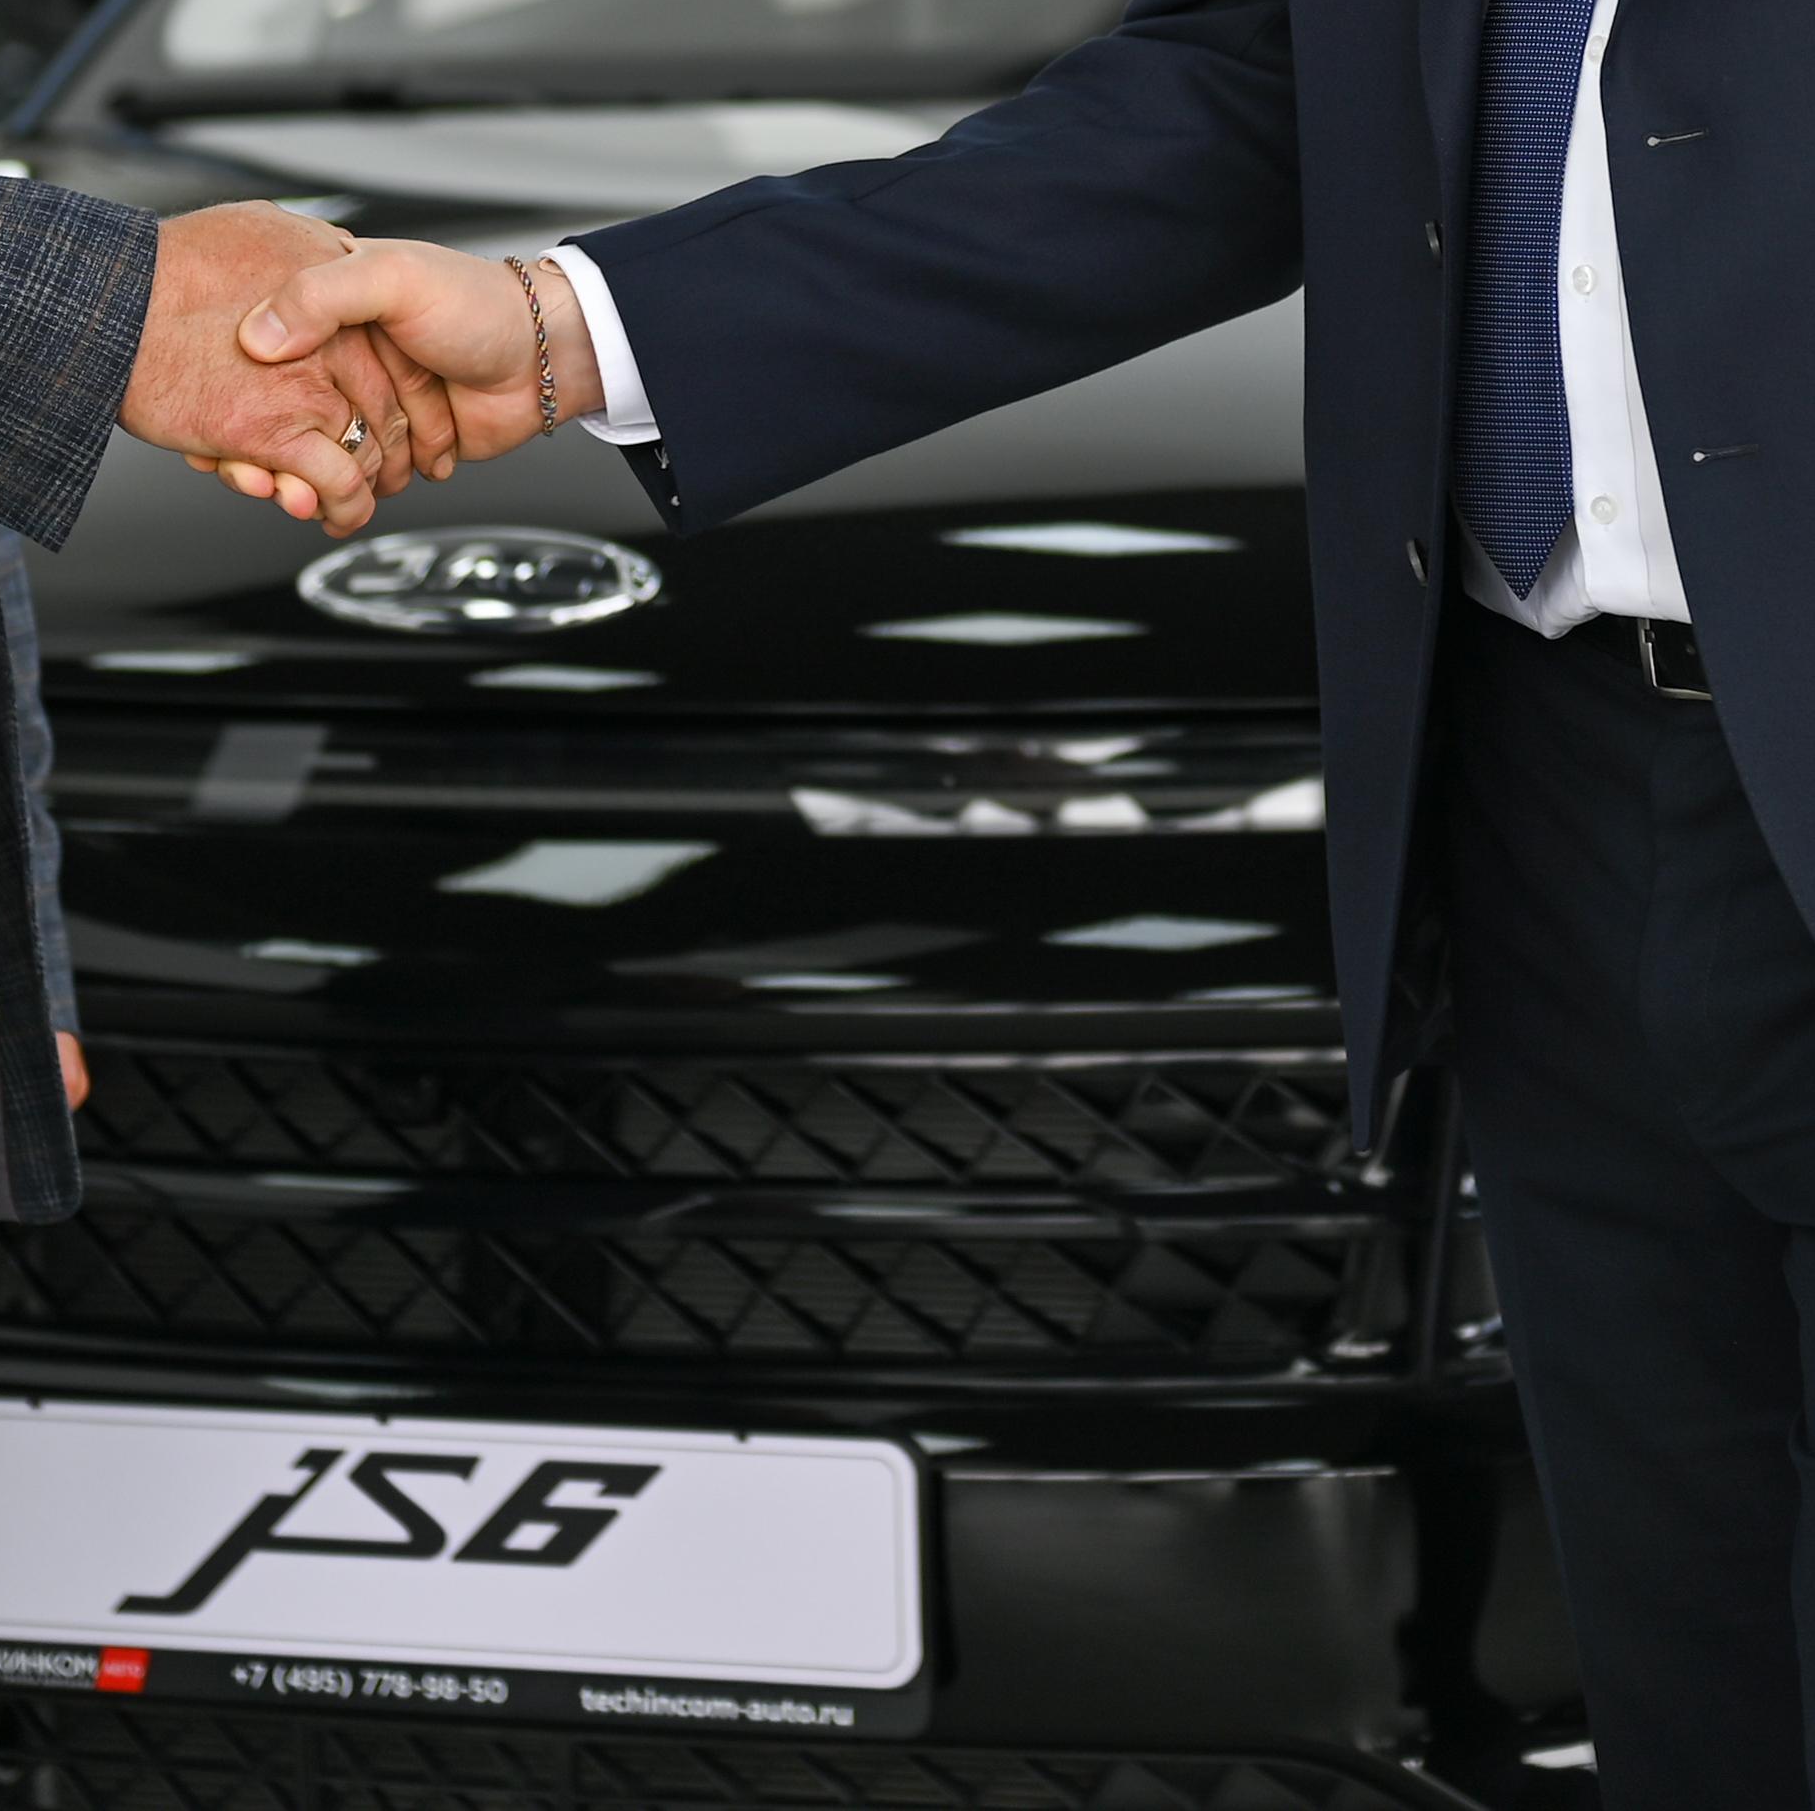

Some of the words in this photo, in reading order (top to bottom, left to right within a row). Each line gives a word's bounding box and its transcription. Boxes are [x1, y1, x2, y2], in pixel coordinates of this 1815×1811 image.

[230, 1661, 268, 1689] +7
[271, 1663, 354, 1699] (495)
[578, 1685, 855, 1727] techincom-auto.ru
